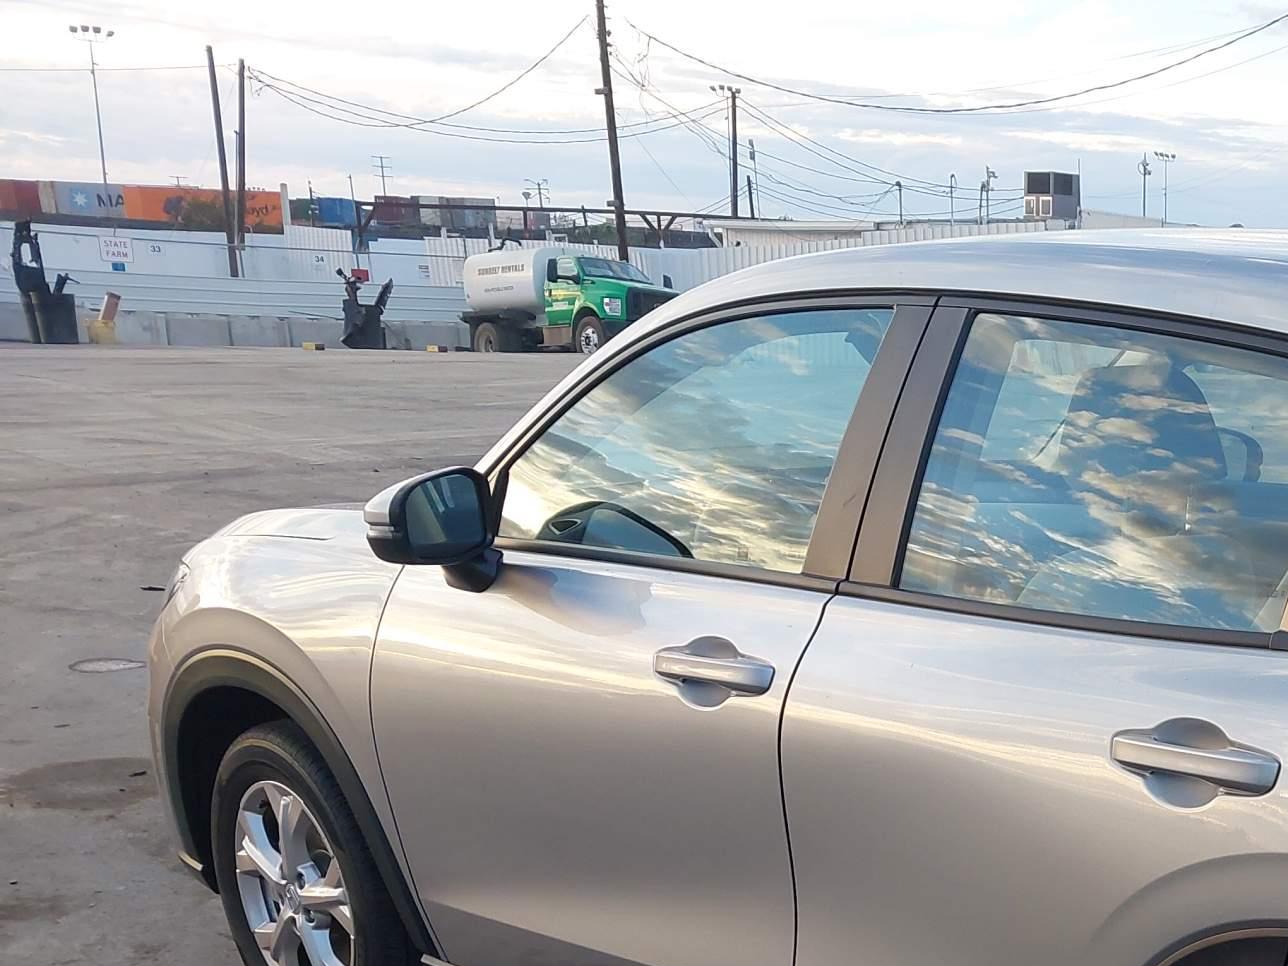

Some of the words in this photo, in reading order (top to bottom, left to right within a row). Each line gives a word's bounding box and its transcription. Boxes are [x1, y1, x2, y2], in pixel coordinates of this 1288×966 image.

[103, 239, 128, 249] STATE
[150, 245, 161, 253] 33
[105, 250, 128, 259] FARM
[314, 255, 325, 263] 34
